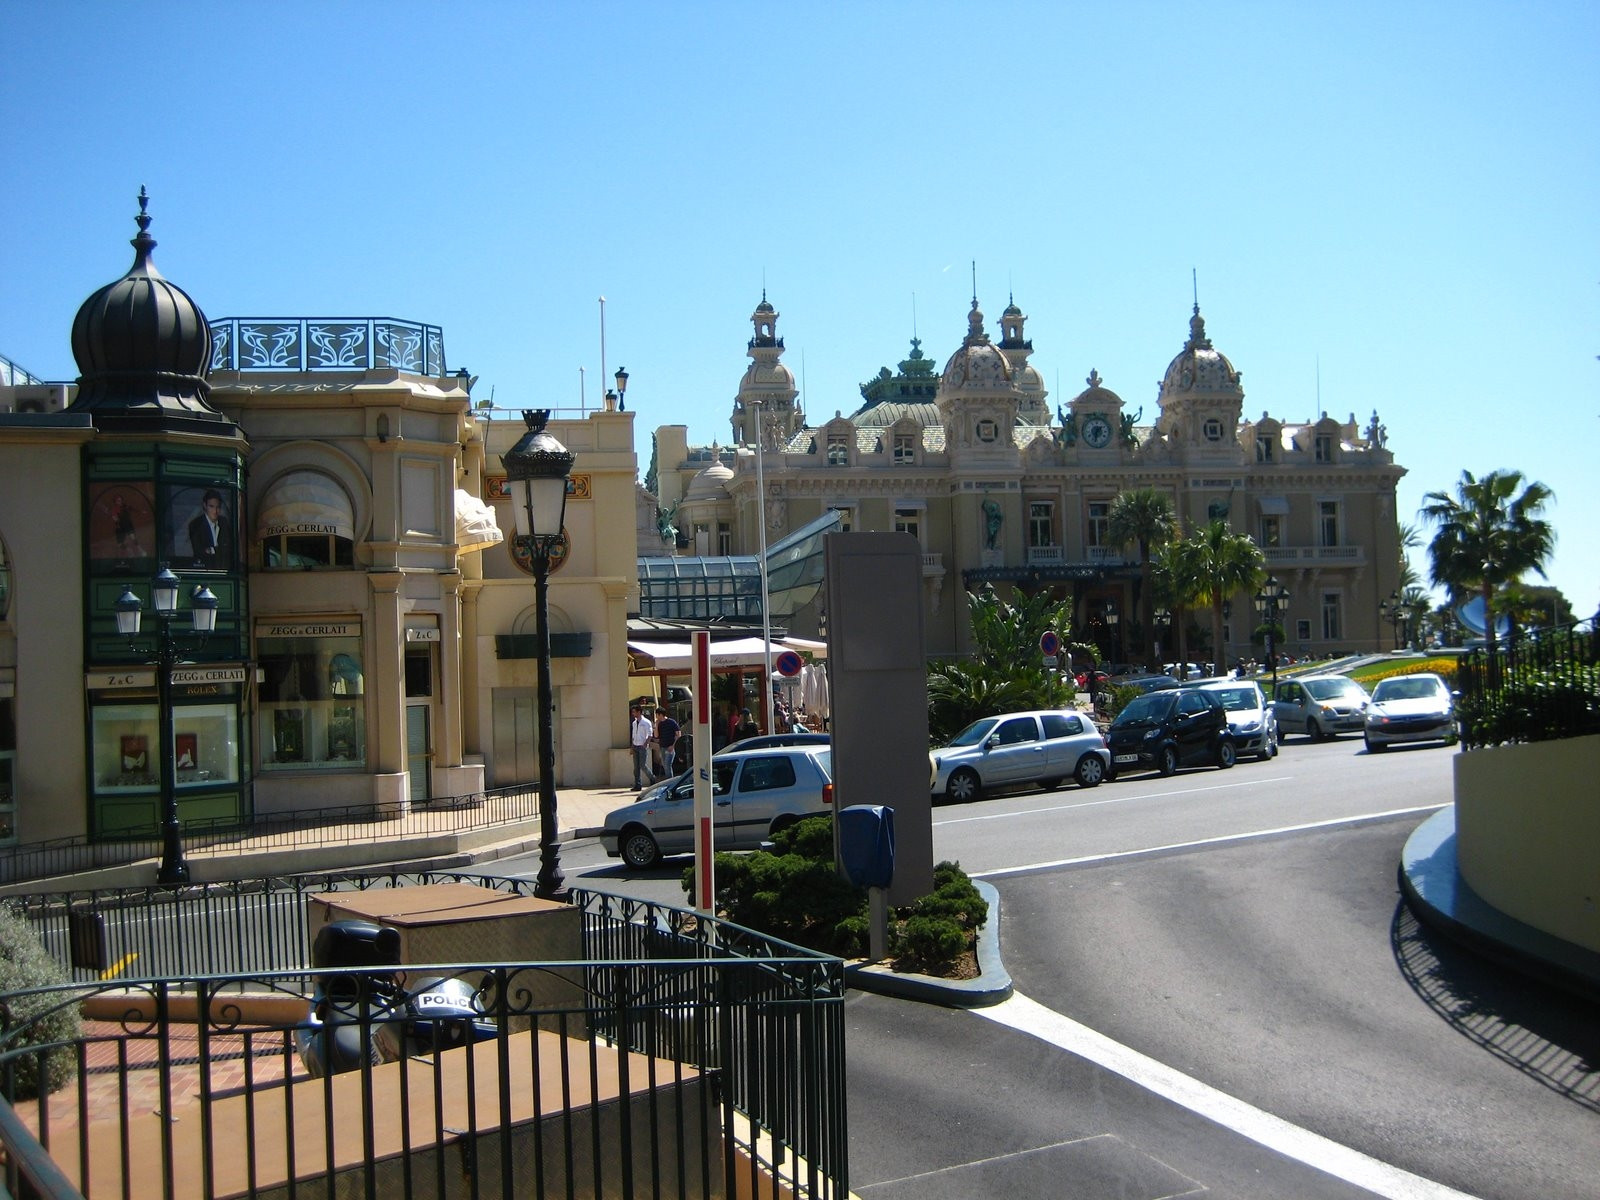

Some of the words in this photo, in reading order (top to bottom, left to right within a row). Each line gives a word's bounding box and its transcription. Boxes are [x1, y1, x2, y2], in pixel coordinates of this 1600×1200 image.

[266, 525, 289, 535] ZEGG
[297, 524, 337, 533] CERLATI
[270, 626, 297, 635] ZEGG
[305, 626, 347, 635] CERLATI
[416, 631, 421, 639] Z
[108, 675, 116, 685] Z
[125, 675, 134, 684] C
[172, 671, 198, 681] ZEGG
[205, 670, 244, 680] CERLATI
[187, 685, 217, 695] ROLEX
